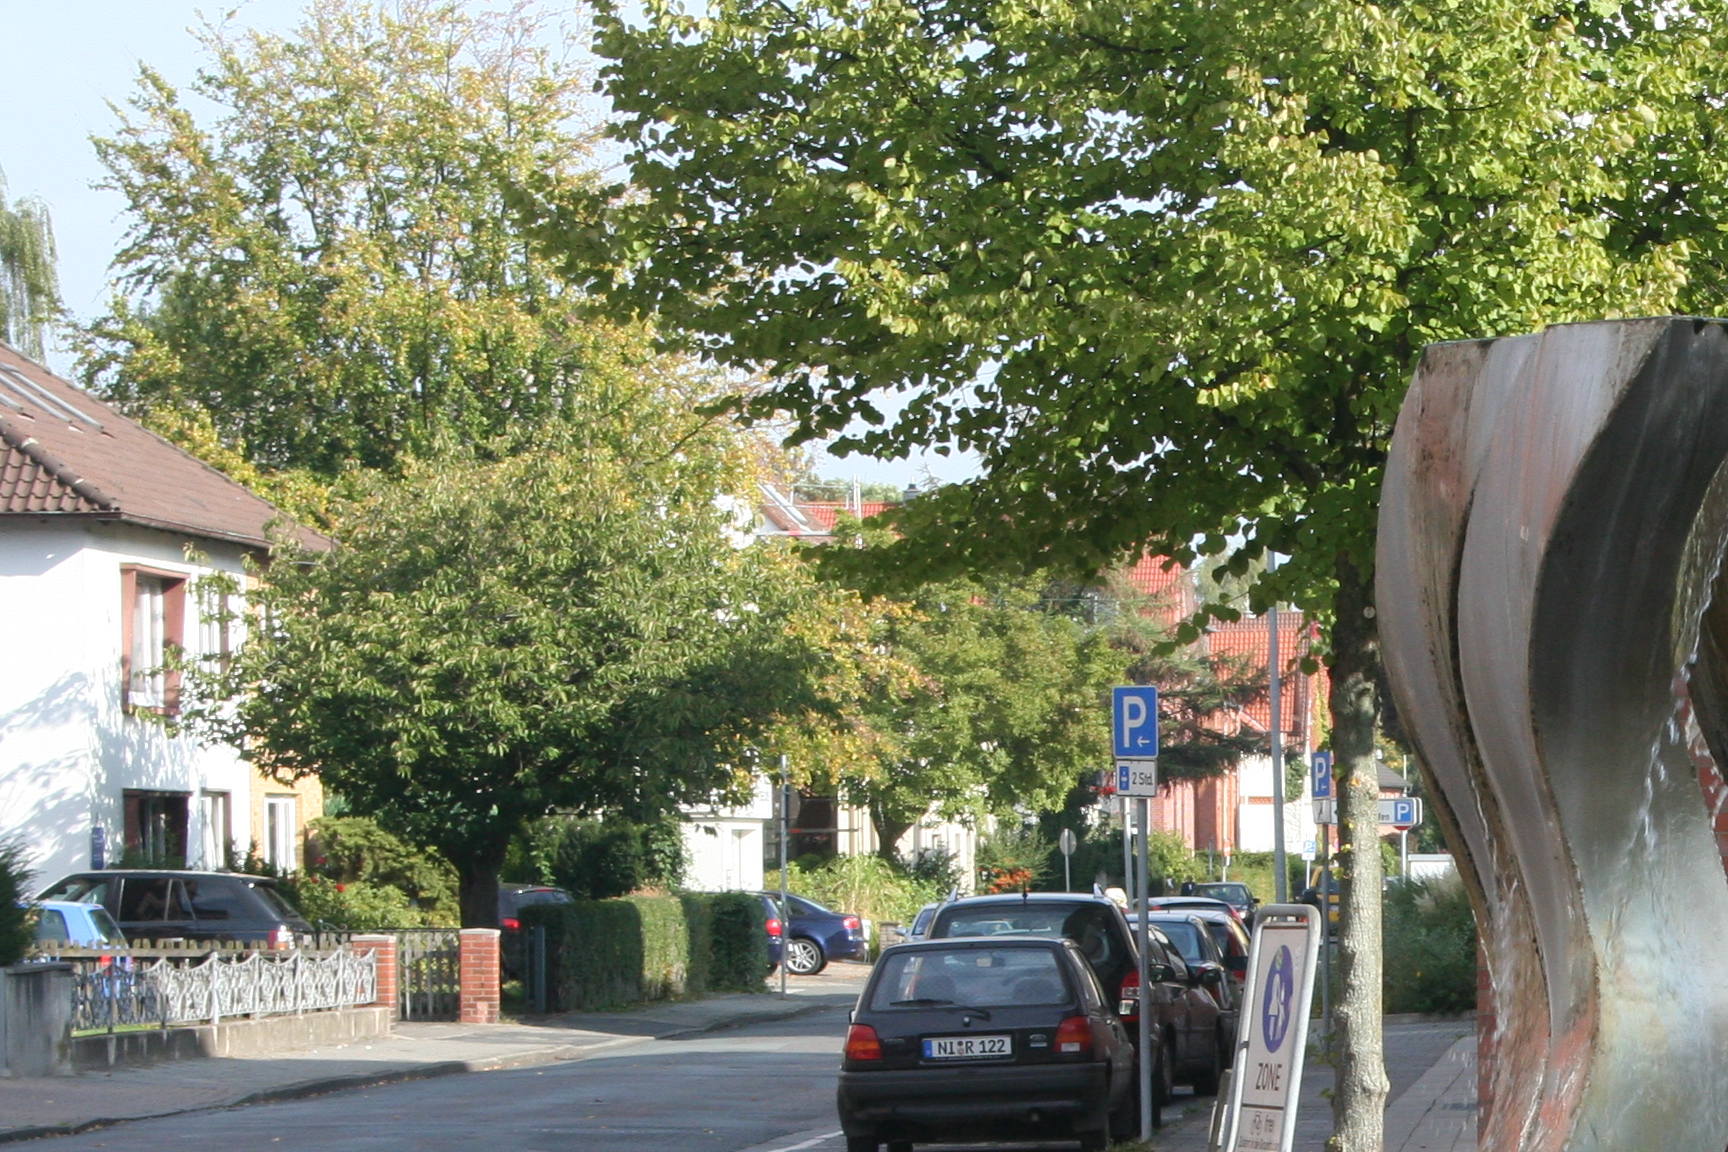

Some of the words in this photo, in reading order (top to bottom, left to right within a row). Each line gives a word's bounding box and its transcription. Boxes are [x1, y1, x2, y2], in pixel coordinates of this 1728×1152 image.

[1123, 696, 1147, 748] P
[1315, 757, 1326, 792] P
[1397, 803, 1409, 821] P
[978, 1039, 1006, 1054] 122
[1255, 1062, 1283, 1092] ZONE
